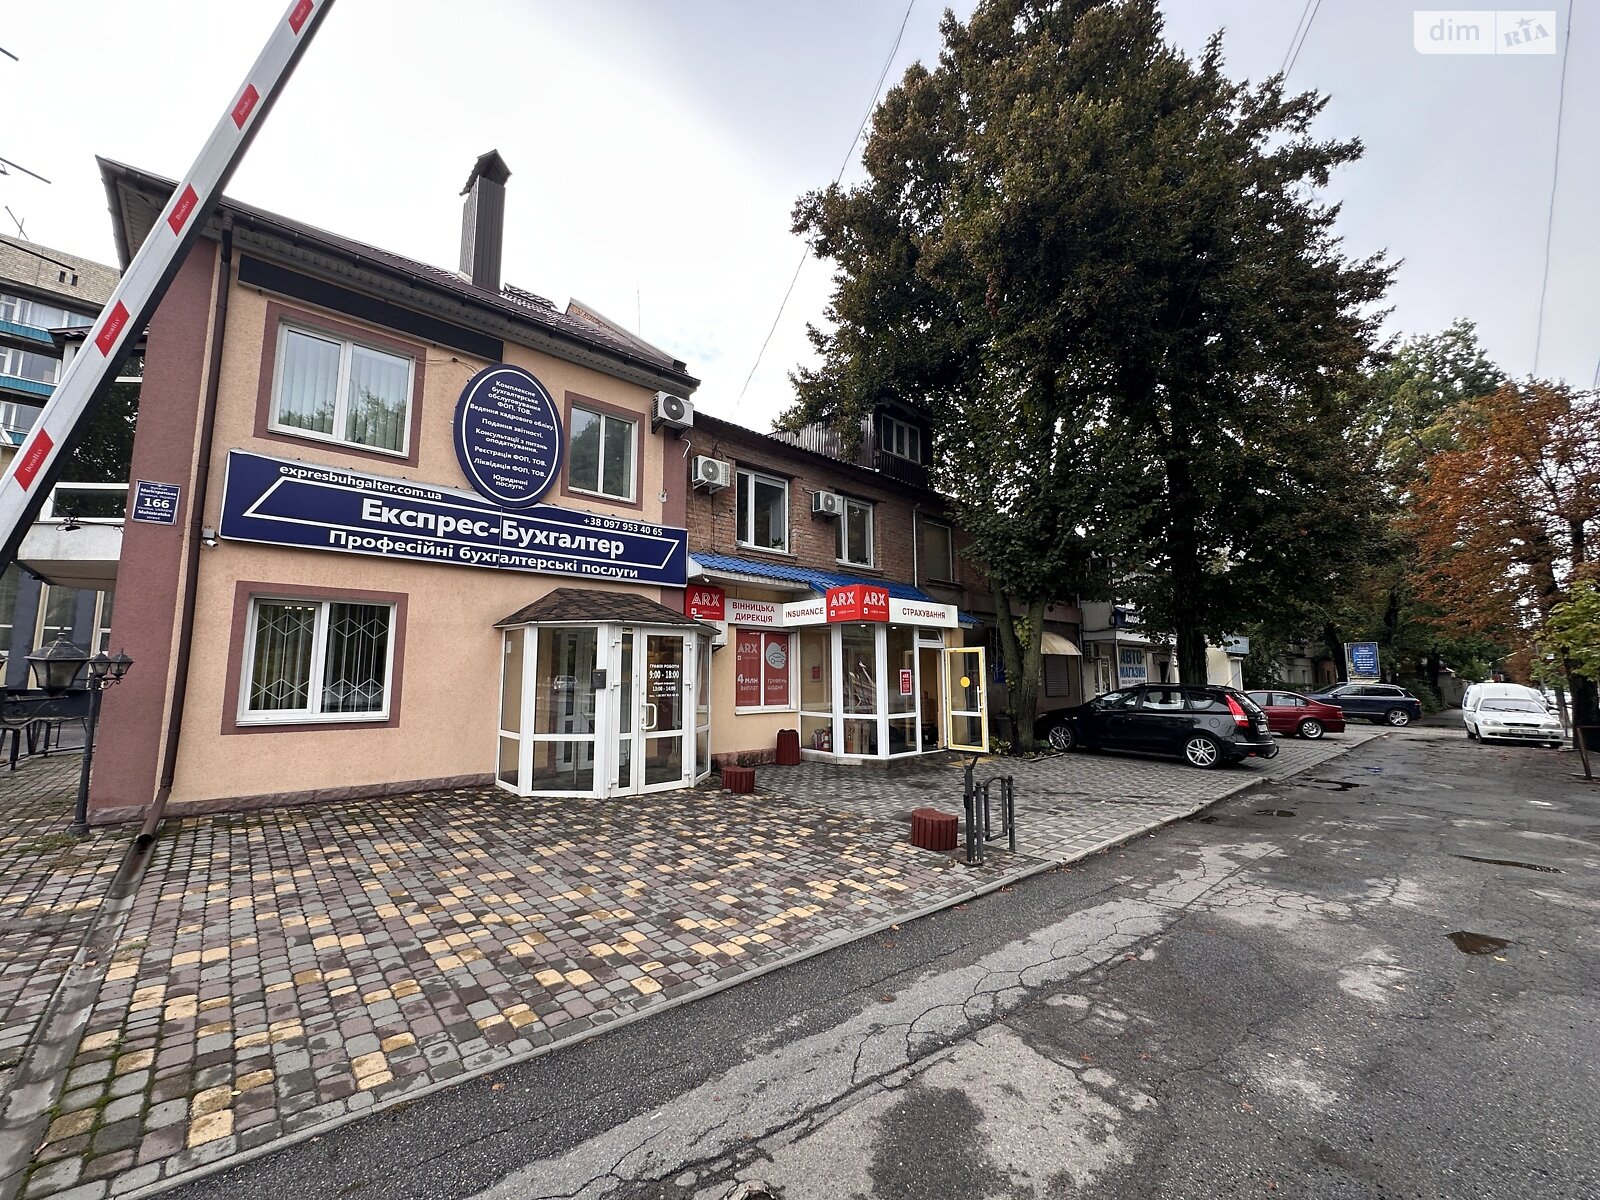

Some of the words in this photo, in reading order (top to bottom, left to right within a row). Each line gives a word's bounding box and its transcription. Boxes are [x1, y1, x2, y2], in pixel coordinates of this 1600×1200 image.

[491, 386, 539, 404] бухгалтерське
[496, 380, 536, 397] Комплексне
[488, 392, 541, 411] обслуговування
[497, 401, 516, 412] ФОП,
[469, 403, 499, 416] Ведення
[499, 412, 533, 425] кадрового
[533, 421, 555, 431] обліку.
[481, 418, 513, 430] Подання
[513, 426, 544, 439] звітності.
[475, 427, 521, 443] Консультації
[525, 440, 548, 450] питань
[485, 437, 539, 453] оподаткування.
[474, 445, 512, 459] Реєстрація
[512, 454, 531, 464] ФОП,
[532, 458, 547, 467] ТОВ.
[473, 457, 511, 470] Ліквідація
[511, 465, 531, 475] ФОП,
[531, 469, 547, 478] ТОВ.
[279, 465, 442, 501] expresbuhgalter.com.ua
[492, 473, 529, 486] Юридичні
[495, 480, 525, 491] послуги.
[143, 497, 170, 509] 166
[361, 498, 624, 559] Експрес-Бухгалтер
[583, 516, 602, 527] +38
[604, 519, 620, 530] 097
[622, 522, 639, 532] 953
[639, 524, 651, 534] 40
[652, 526, 663, 536] 65
[329, 530, 453, 557] Професійні
[459, 546, 577, 572] бухгалтерські
[582, 562, 638, 579] послуги
[691, 592, 720, 607] ARX
[732, 601, 775, 613] ВІННИЦЬКА
[830, 591, 855, 607] ARX
[863, 591, 886, 607] ARX
[734, 612, 773, 623] ДИРЕКЦІЯ
[785, 607, 824, 618] INSURANCE
[902, 607, 946, 619] СТРАХУВАННЯ
[737, 643, 758, 653] ARX
[1119, 648, 1145, 664] АВТО-
[649, 670, 661, 679] 9:00
[665, 670, 680, 679] 18:00
[737, 673, 745, 684] 4
[1119, 666, 1146, 678] МАГАЗИН
